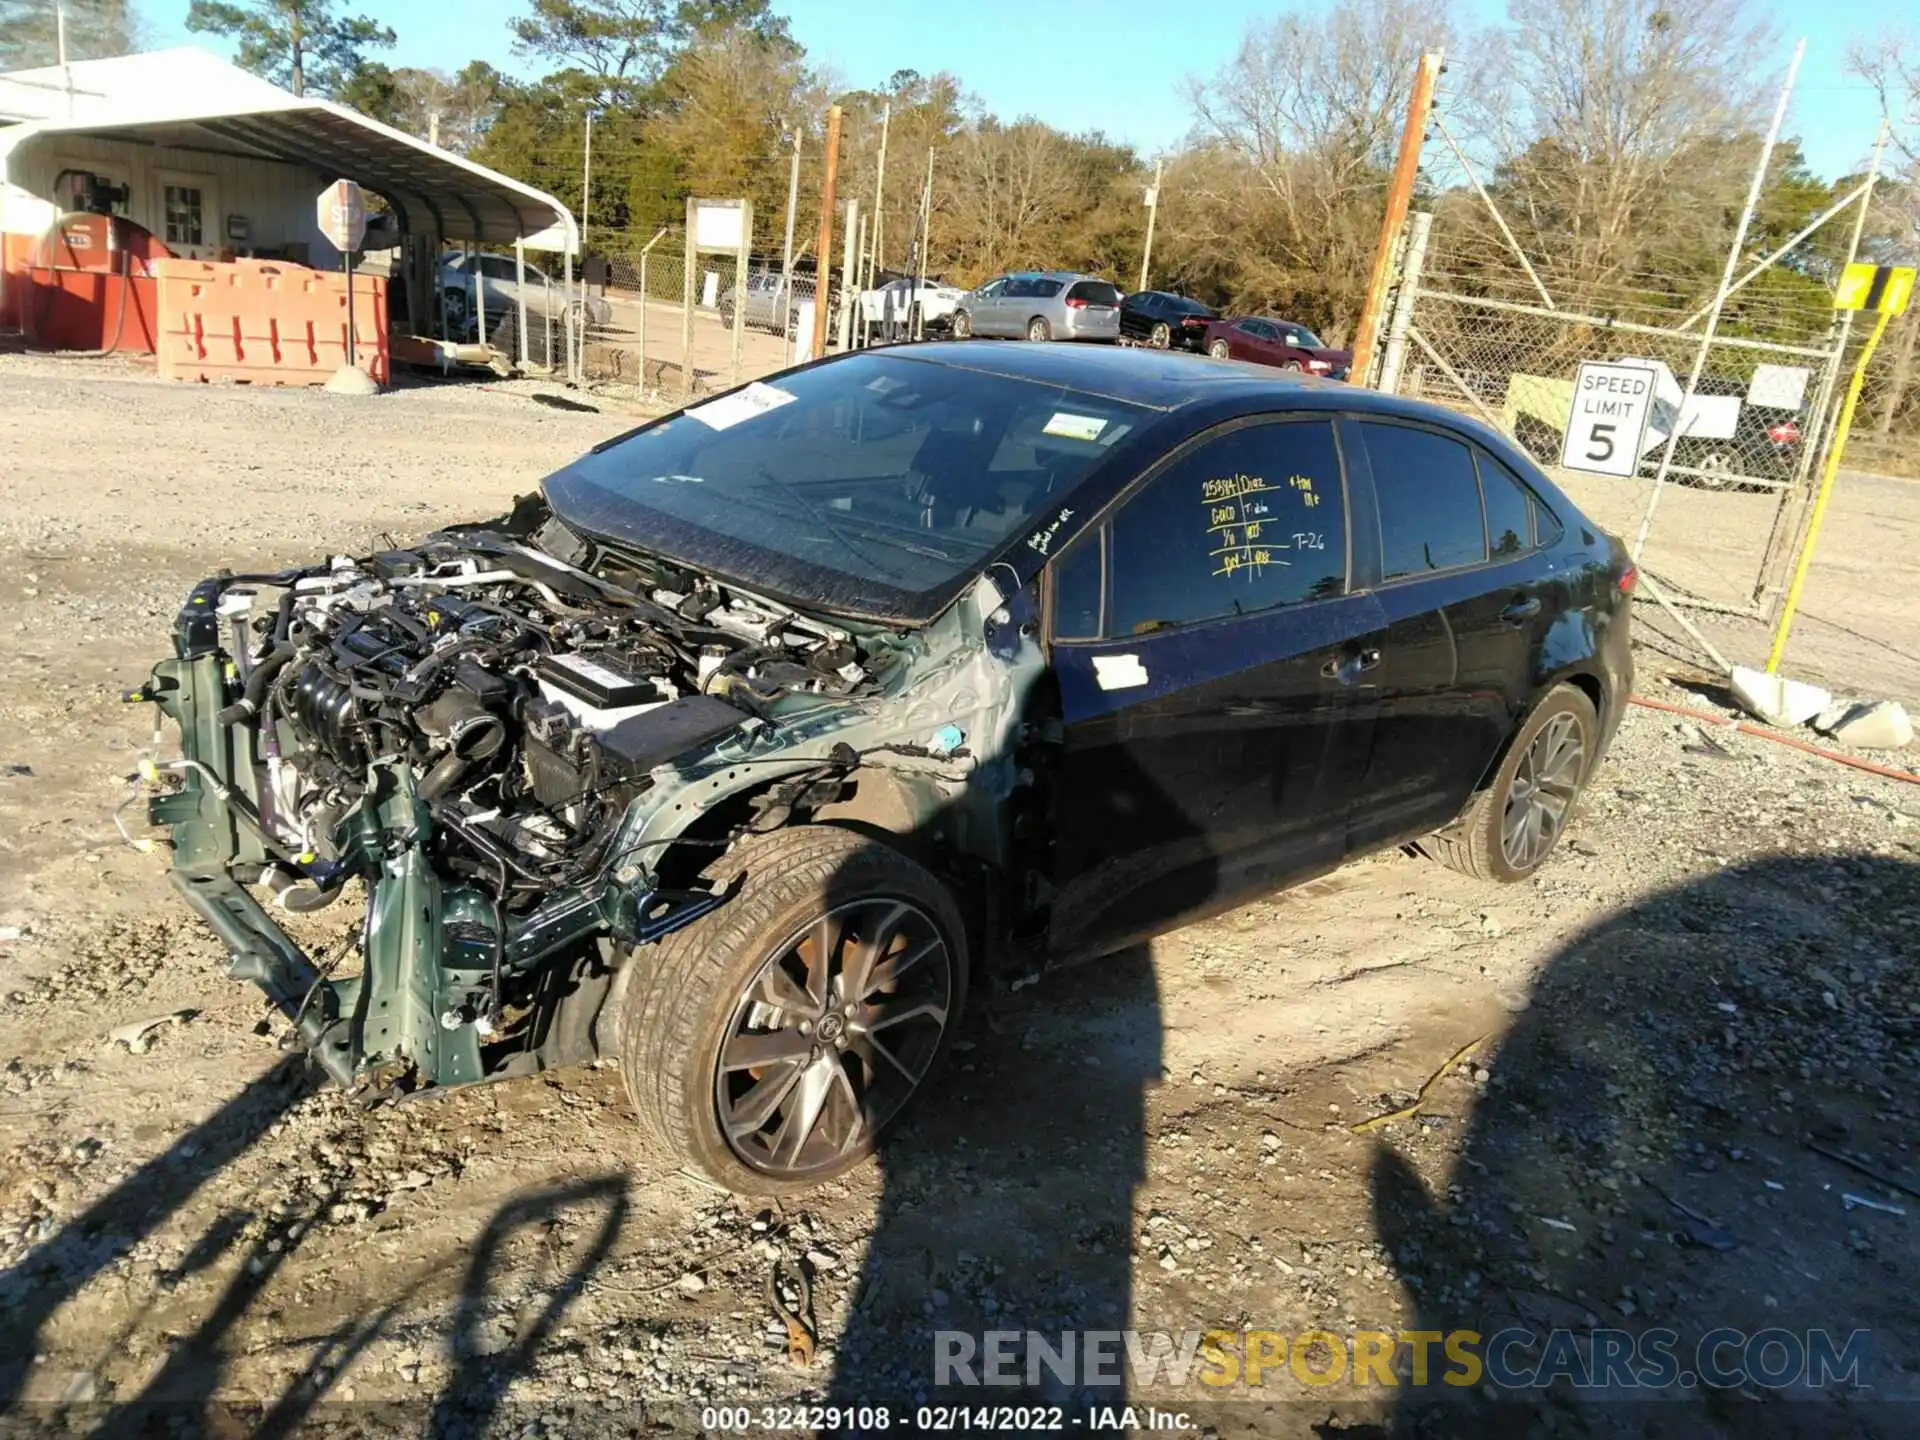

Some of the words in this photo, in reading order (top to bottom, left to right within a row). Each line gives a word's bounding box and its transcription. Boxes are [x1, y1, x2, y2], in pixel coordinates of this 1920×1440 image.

[1583, 374, 1646, 396] SPEED
[1583, 399, 1634, 418] LIMIT
[1585, 423, 1617, 462] 5
[1292, 531, 1325, 550] T-26
